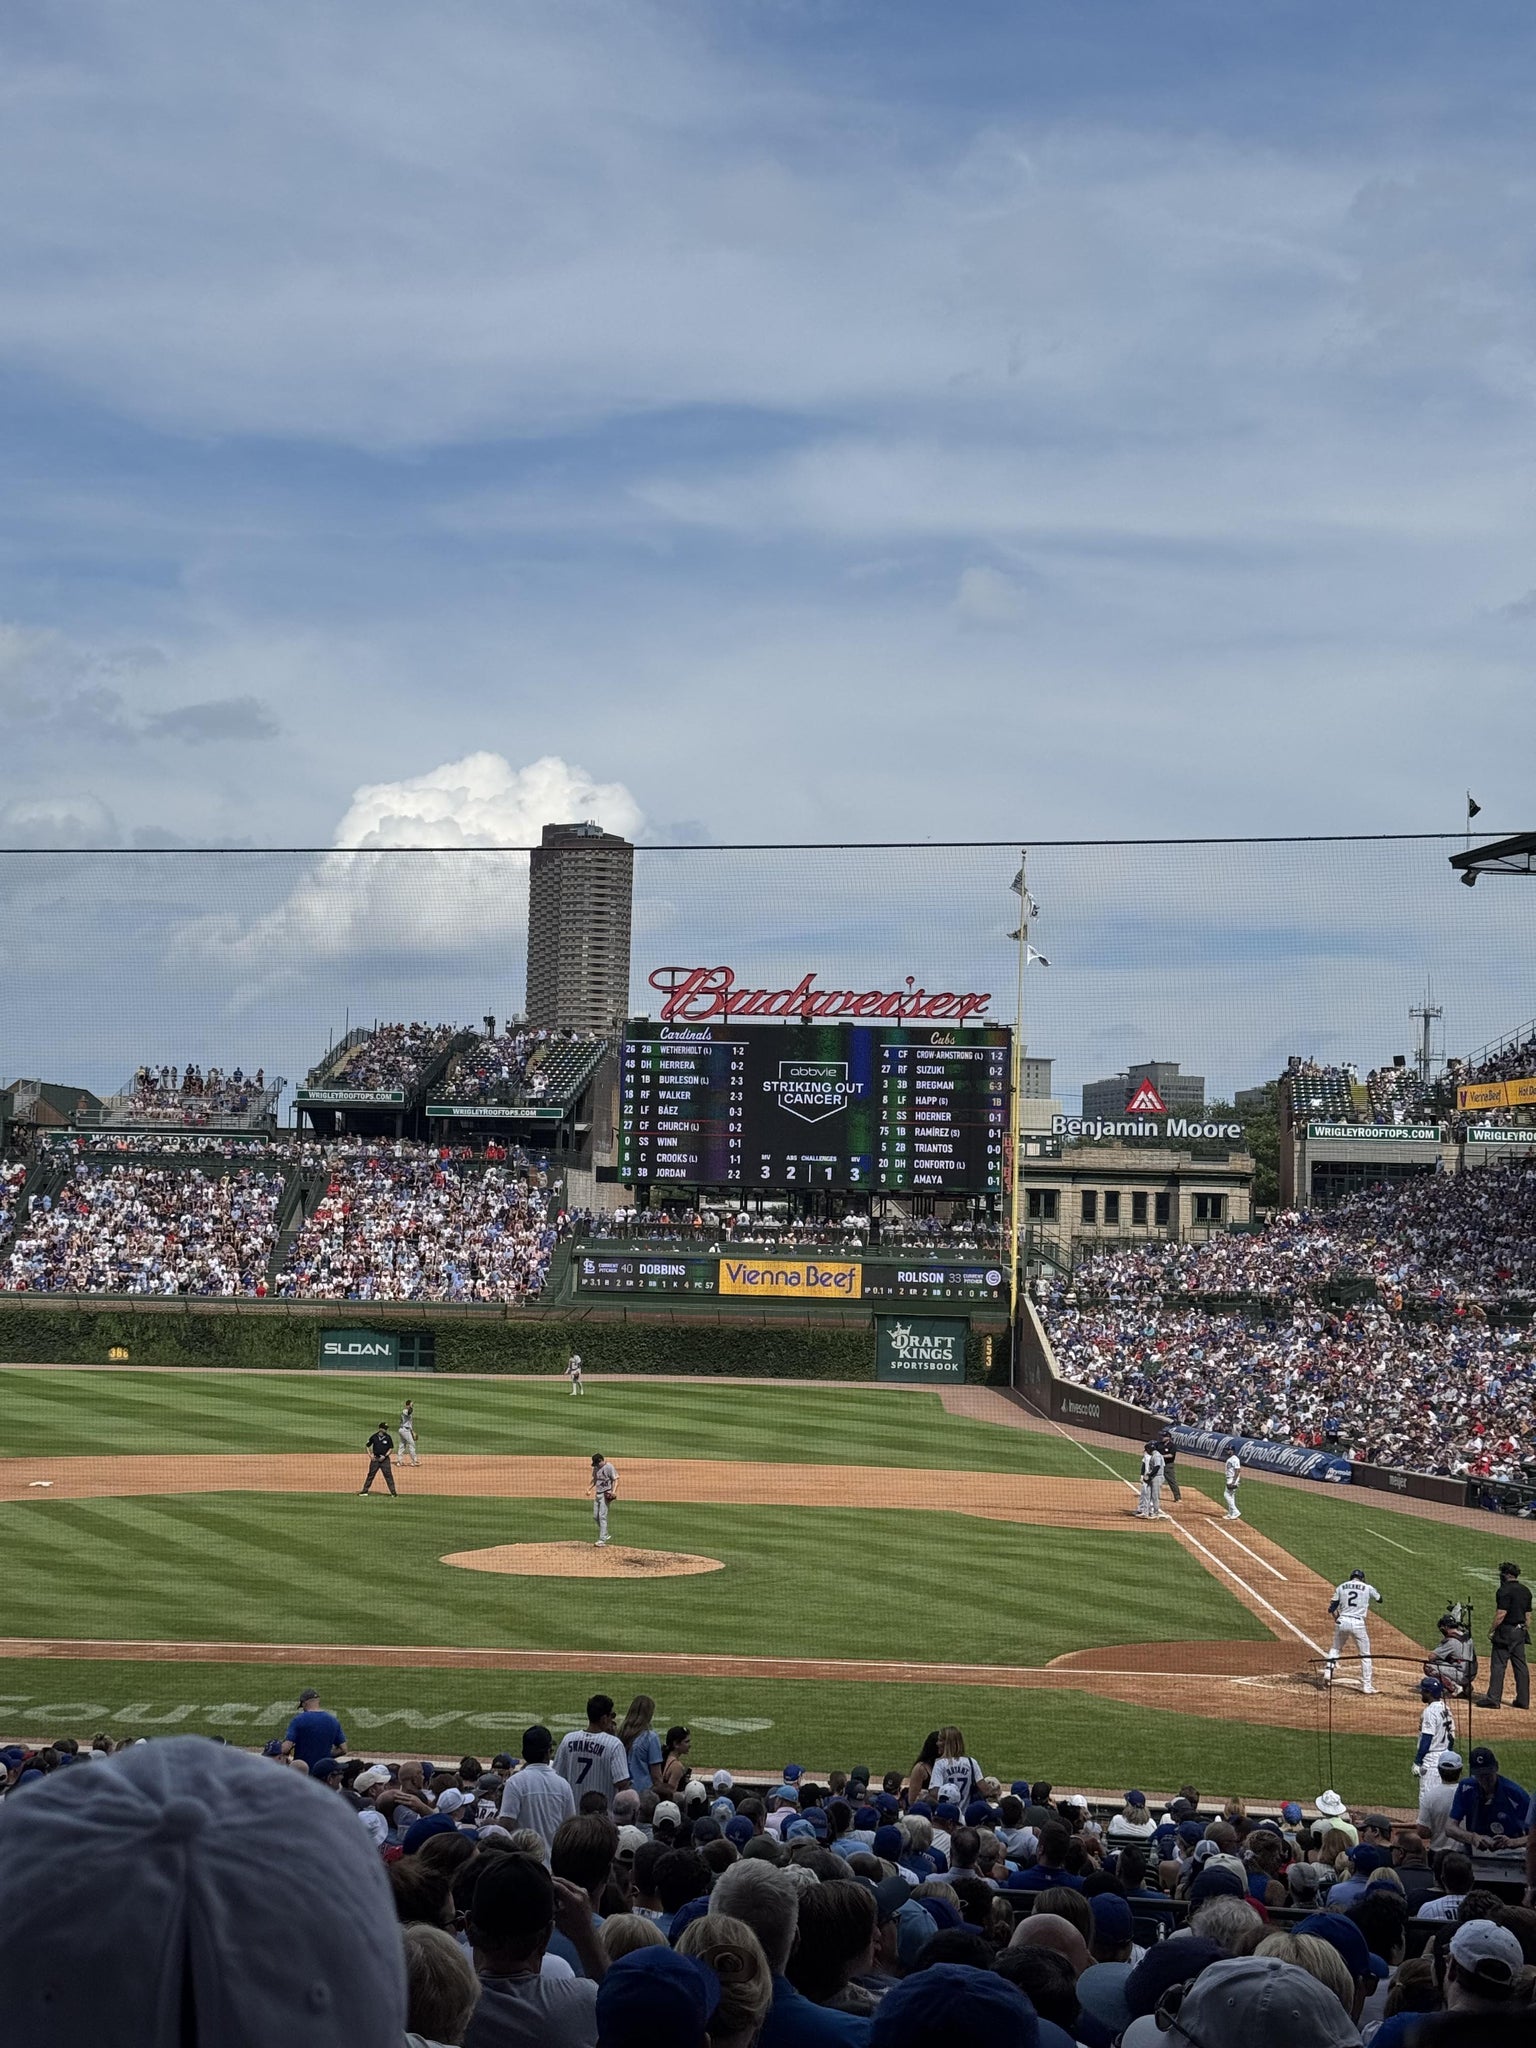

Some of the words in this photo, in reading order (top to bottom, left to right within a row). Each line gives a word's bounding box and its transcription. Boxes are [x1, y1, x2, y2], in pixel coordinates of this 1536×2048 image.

[648, 966, 992, 1021] Budweiser
[660, 1027, 712, 1040] Cardinals
[930, 1032, 956, 1045] Cubs
[660, 1046, 702, 1055] WETHERHOLT
[884, 1050, 889, 1058] 4
[917, 1052, 973, 1060] CROW-ARMSTRONG
[641, 1060, 652, 1068] DH
[660, 1061, 695, 1069] HERRERA
[731, 1062, 744, 1070] 0-2
[790, 1067, 836, 1076] abbvie
[916, 1066, 945, 1074] SUZUKI
[989, 1067, 1002, 1076] 0-2
[763, 1082, 832, 1093] STRIKING
[835, 1083, 864, 1093] OUT
[897, 1081, 908, 1089] 3B
[989, 1082, 1002, 1090] 6-3
[308, 1091, 392, 1101] WRIGLEYROOFTOPS.COM
[625, 1090, 633, 1098] 18
[659, 1091, 690, 1099] WALKER
[730, 1092, 742, 1100] 2-3
[784, 1094, 841, 1104] CANCER
[882, 1096, 888, 1104] 8
[898, 1096, 906, 1104] LF
[916, 1096, 937, 1104] HAPP
[992, 1098, 1001, 1106] 1B
[453, 1107, 537, 1117] WRIGLEYROOFTOPS.COM
[624, 1106, 633, 1114] 22
[641, 1106, 649, 1114] LF
[730, 1107, 742, 1116] 0-3
[882, 1111, 887, 1120] 2
[897, 1112, 907, 1120] SS
[915, 1112, 951, 1121] HOERNER
[989, 1113, 1001, 1122] 0-1
[624, 1121, 632, 1129] 27
[658, 1122, 689, 1131] CHURCH
[691, 1123, 699, 1131] (L)
[729, 1123, 742, 1132] 0-2
[1052, 1116, 1158, 1141] Benjamin
[1166, 1118, 1242, 1139] Moore
[880, 1127, 889, 1135] 75
[897, 1127, 906, 1135] 1B
[951, 1130, 960, 1138] (S)
[989, 1129, 1001, 1138] 0-1
[1315, 1126, 1434, 1140] WRIGLEYROOFTOPS.COM
[625, 1137, 630, 1145] 0
[639, 1137, 649, 1146] SS
[657, 1138, 678, 1146] WINN
[730, 1139, 741, 1147] 0-1
[882, 1143, 886, 1151] 5
[896, 1143, 906, 1151] 2B
[915, 1144, 953, 1153] TRIANTOS
[987, 1145, 1000, 1154] 0-0
[641, 1153, 646, 1161] C
[657, 1154, 687, 1162] CROOKS
[730, 1155, 740, 1164] 1-1
[879, 1159, 888, 1167] 20
[895, 1160, 906, 1168] DH
[914, 1160, 954, 1169] CONFORTO
[988, 1162, 1000, 1170] 0-1
[622, 1168, 631, 1176] 33
[638, 1168, 648, 1176] 3B
[656, 1169, 686, 1177] JORDAN
[728, 1170, 740, 1179] 2-2
[761, 1166, 770, 1179] 3
[786, 1167, 796, 1179] 2
[825, 1168, 832, 1180] 1
[850, 1168, 859, 1181] 3
[881, 1174, 886, 1182] 9
[897, 1174, 903, 1183] C
[914, 1175, 942, 1184] AMAYA
[988, 1177, 1000, 1185] 0-1
[621, 1264, 633, 1273] 40
[640, 1264, 685, 1275] DOBBINS
[726, 1263, 800, 1286] Vienna
[806, 1266, 856, 1294] Beef
[898, 1272, 944, 1283] ROLISON
[948, 1274, 961, 1283] 33
[891, 1334, 955, 1349] DRAFT
[899, 1347, 953, 1360] KINGS
[890, 1362, 958, 1371] SPORTSBOOK
[1196, 1432, 1219, 1456] Wrap
[1239, 1440, 1280, 1463] Reynolds
[1276, 1447, 1306, 1473] Wrap
[1348, 1591, 1358, 1607] 2
[568, 1740, 606, 1758] SWANSON
[575, 1756, 593, 1785] 7
